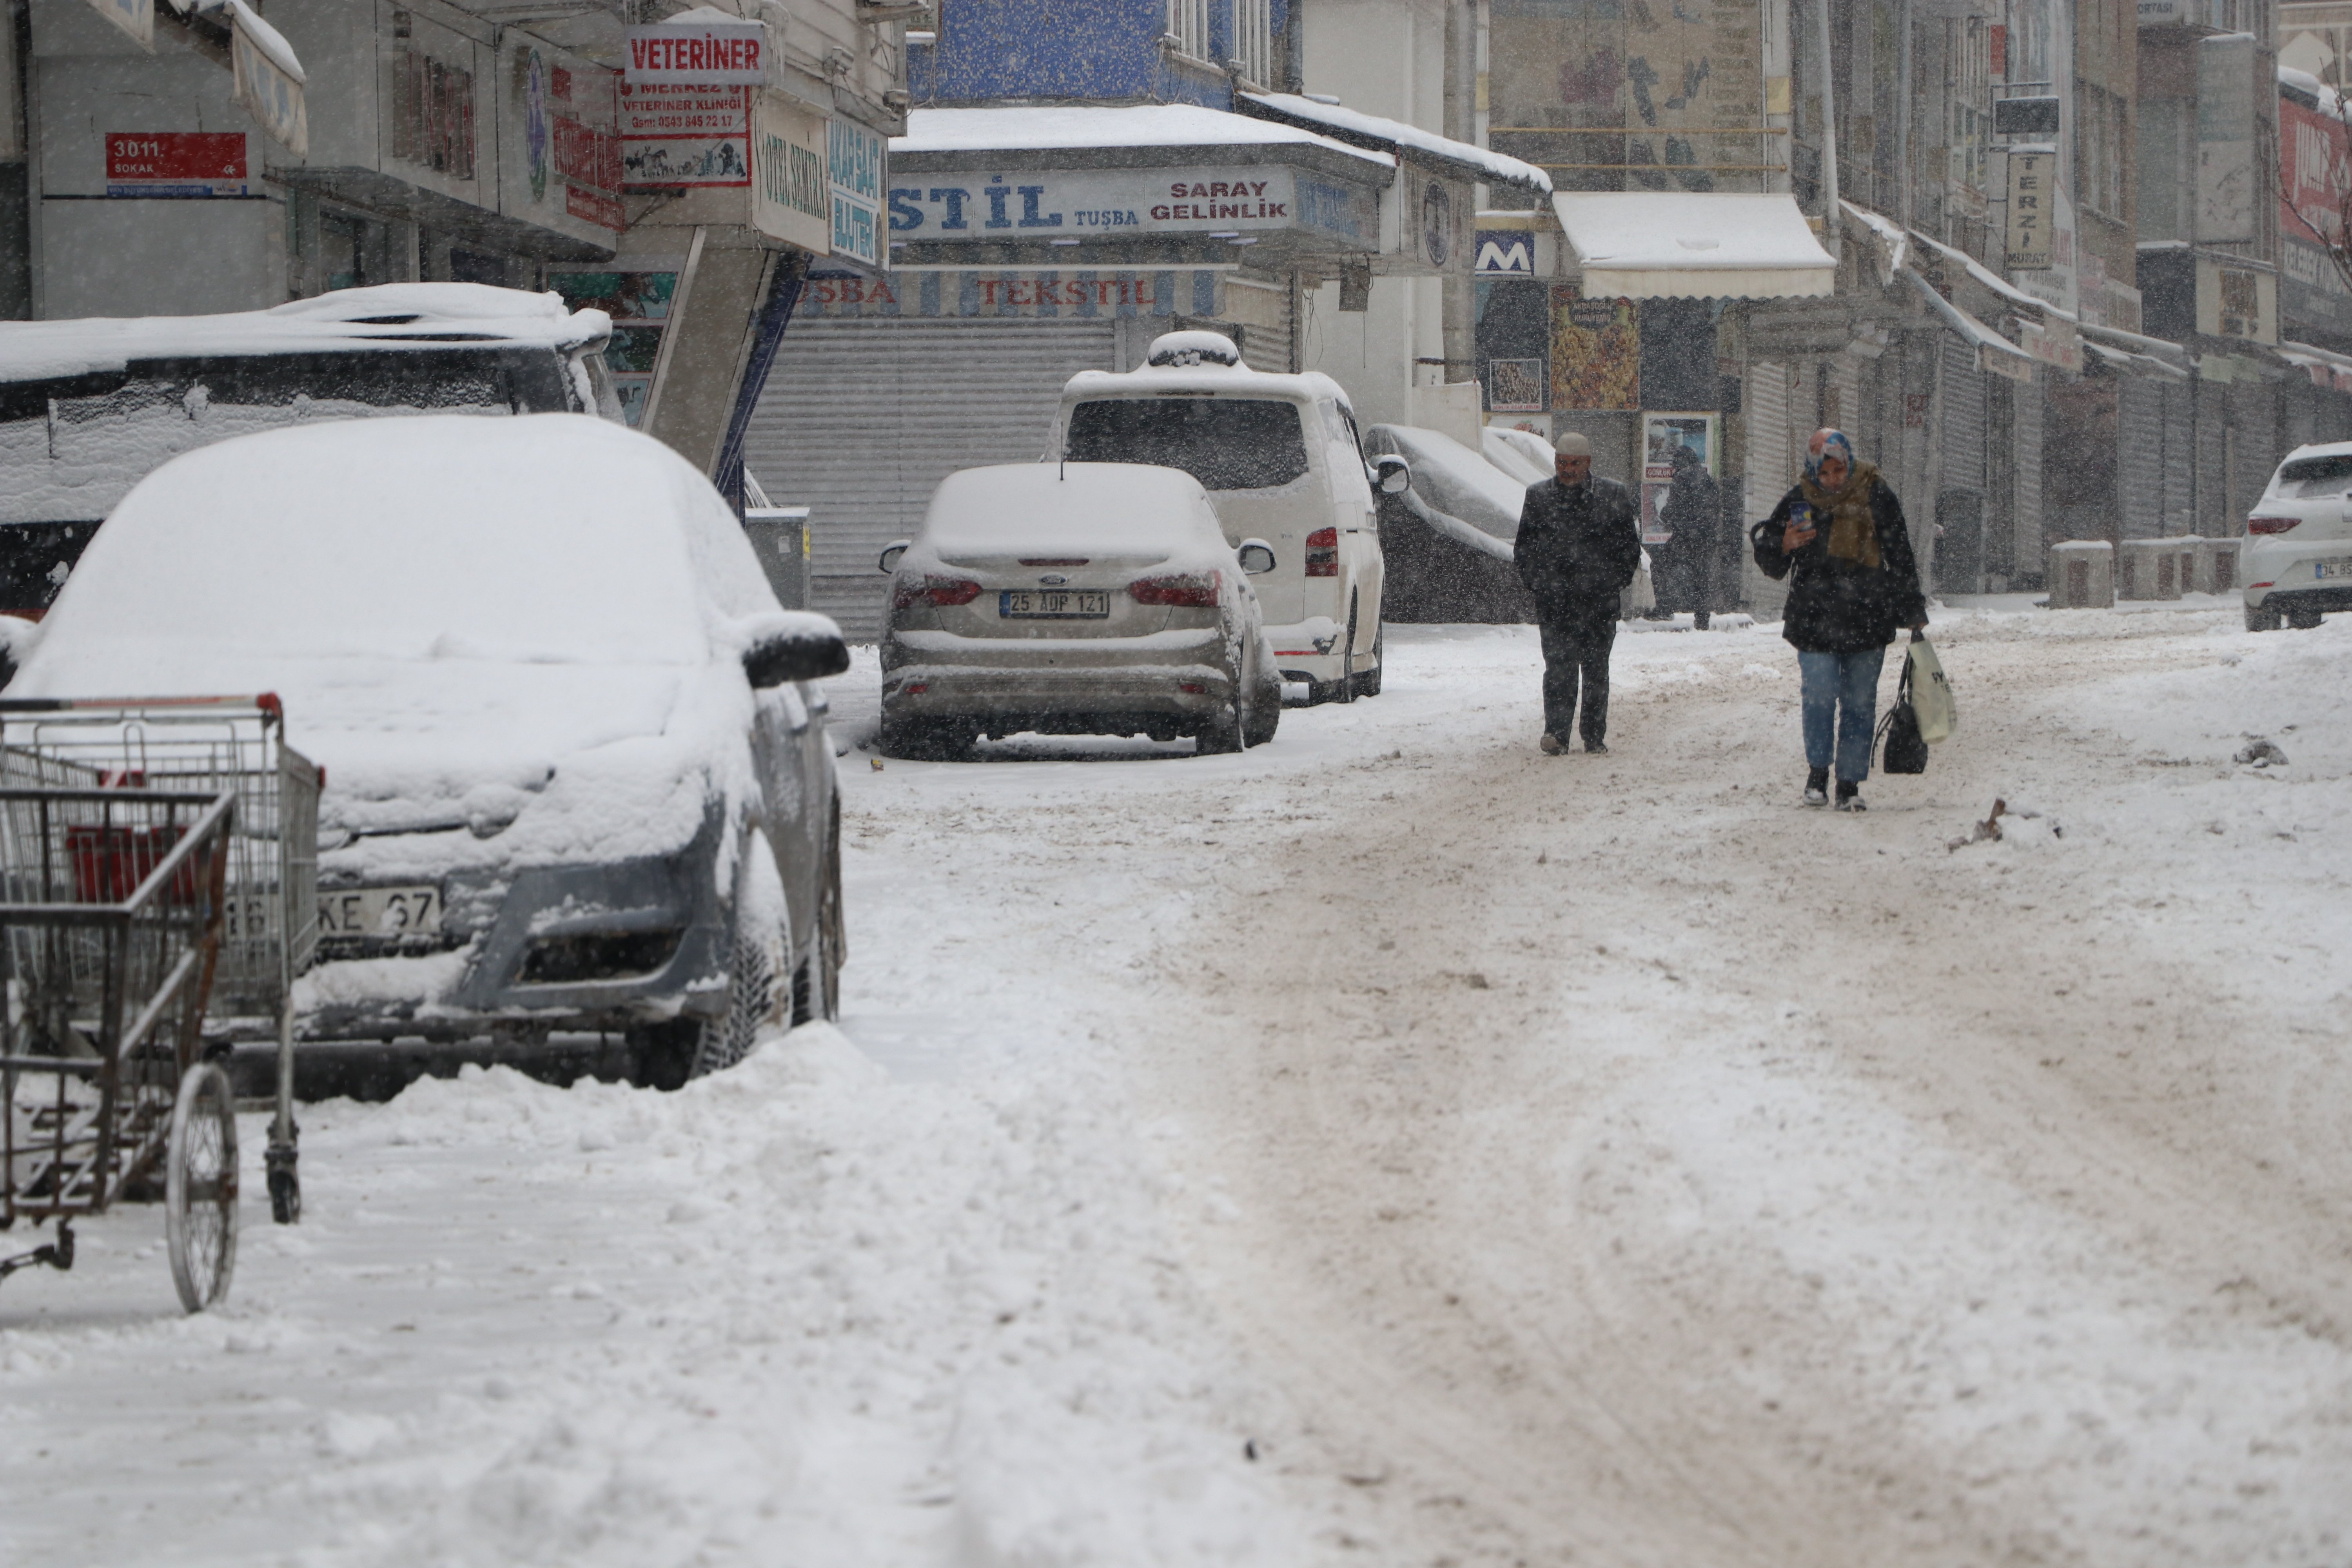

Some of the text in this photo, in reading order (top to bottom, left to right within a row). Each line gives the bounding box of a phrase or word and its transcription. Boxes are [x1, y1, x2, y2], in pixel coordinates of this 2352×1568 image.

[631, 33, 760, 70] VETERİNER
[659, 116, 682, 127] 0543
[686, 116, 703, 127] 845
[706, 116, 718, 127] 22
[721, 114, 733, 127] 17
[114, 141, 164, 158] 3011.
[115, 163, 153, 173] SOKAK
[766, 132, 789, 207] OTEL
[1171, 181, 1268, 198] SARAY
[1151, 198, 1287, 220] GELİNLİK
[1074, 210, 1139, 230] TUŞBA
[1011, 595, 1030, 611] 25
[1078, 595, 1104, 612] 121
